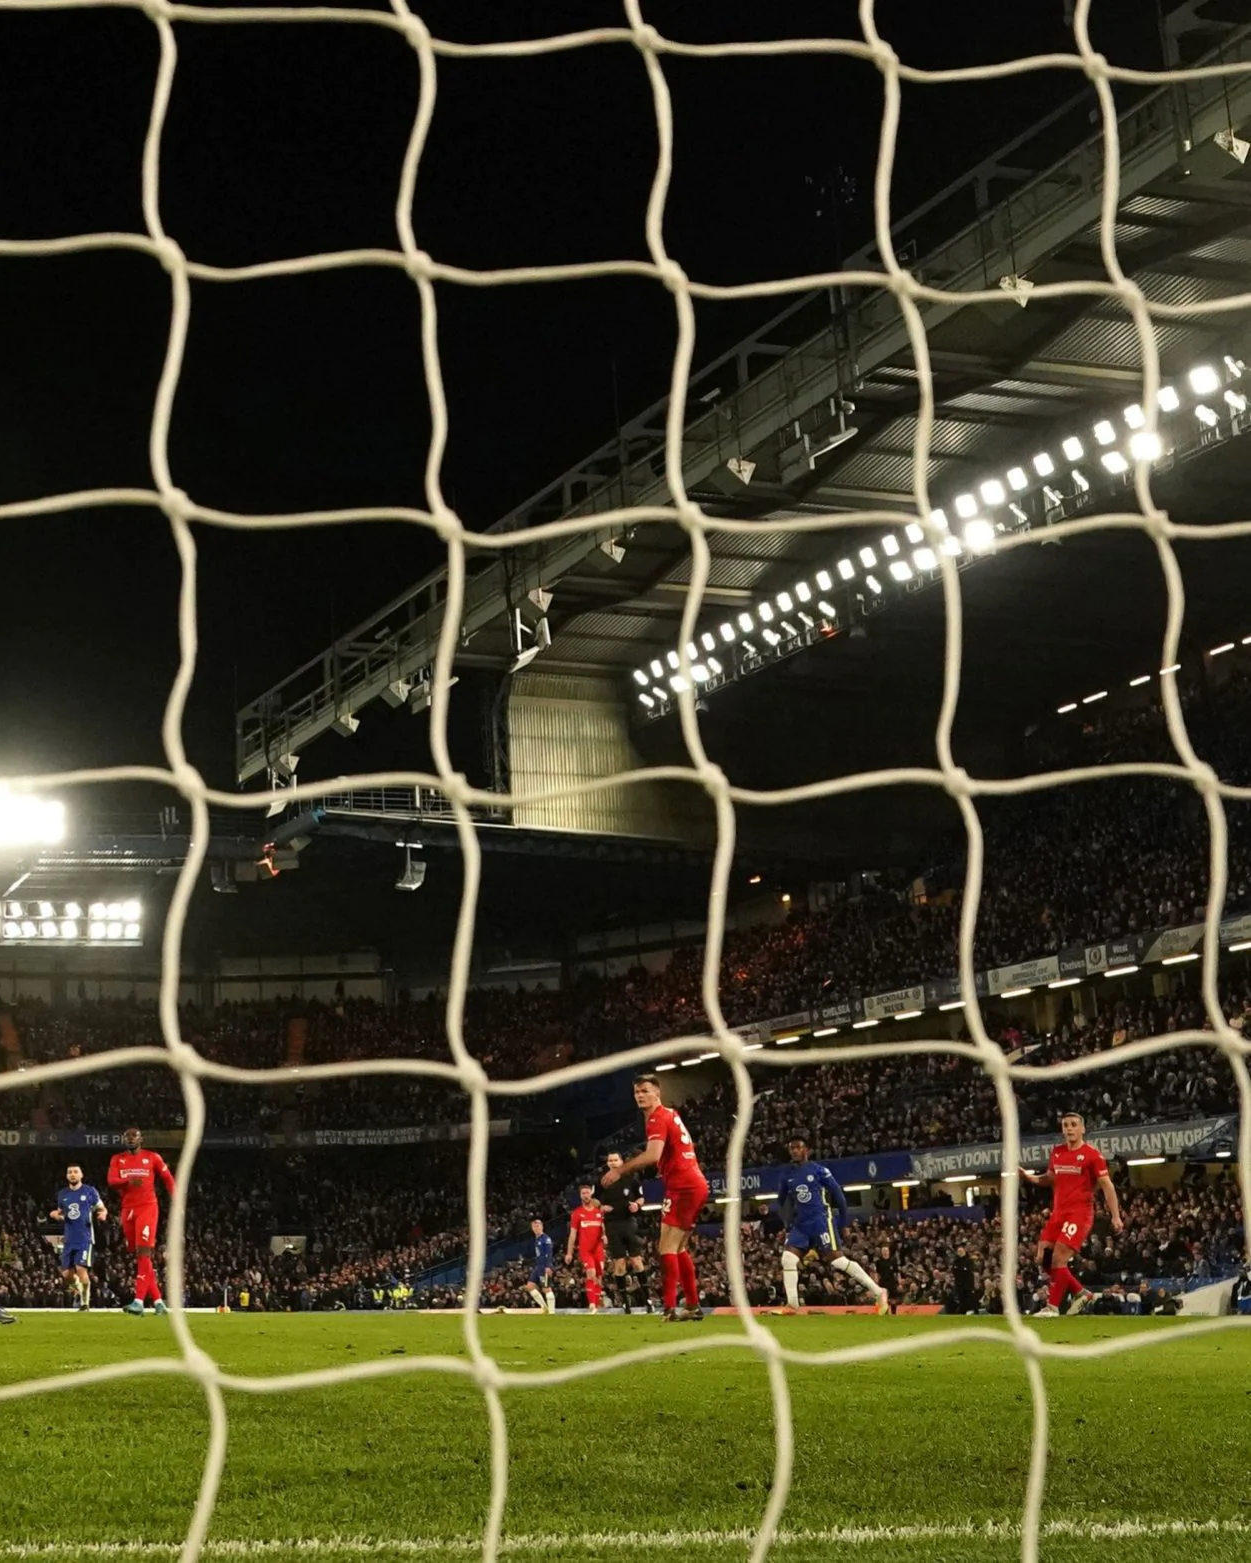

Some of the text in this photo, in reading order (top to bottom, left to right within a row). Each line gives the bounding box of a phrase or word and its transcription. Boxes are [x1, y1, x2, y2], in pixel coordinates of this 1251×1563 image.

[84, 1135, 107, 1145] THE
[935, 1154, 965, 1173] THEY
[142, 1225, 150, 1237] 4
[820, 1232, 831, 1245] 10
